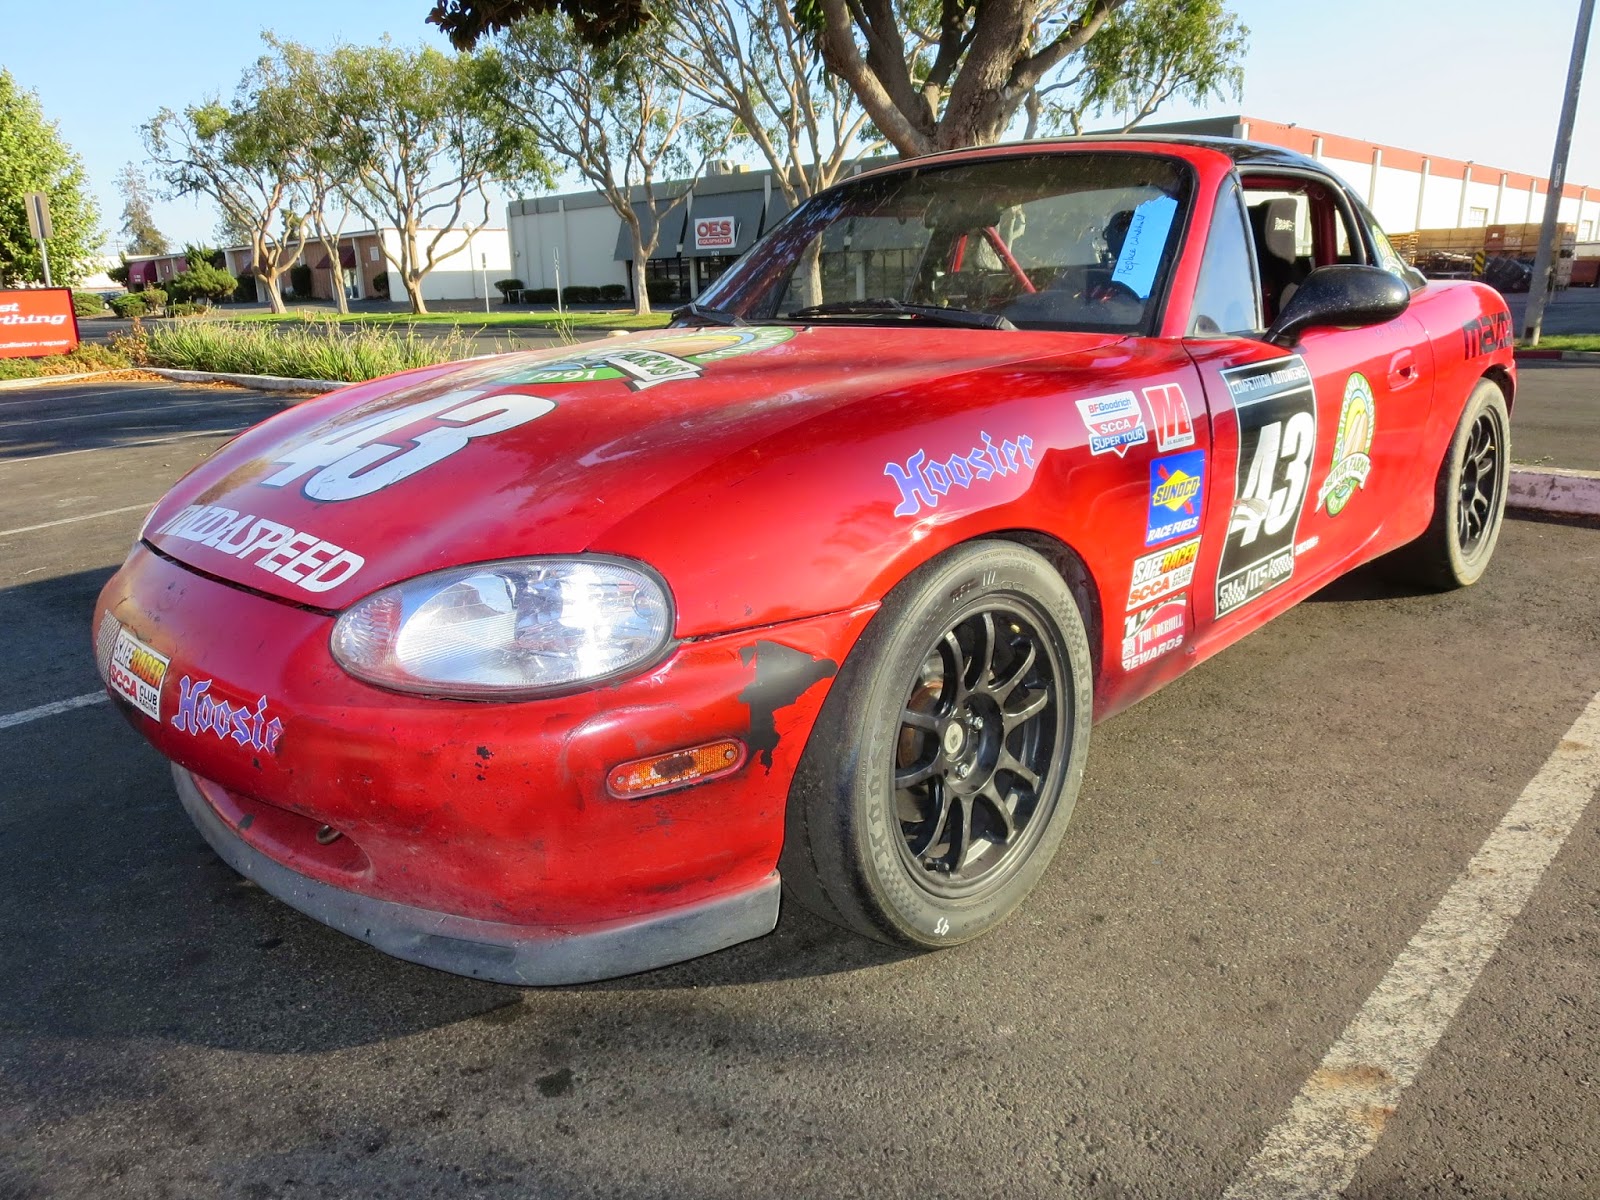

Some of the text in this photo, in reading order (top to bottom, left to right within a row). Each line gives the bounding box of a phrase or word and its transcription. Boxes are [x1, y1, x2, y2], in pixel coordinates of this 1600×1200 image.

[697, 220, 731, 237] OES
[698, 237, 731, 245] EQUIPMENT
[0, 314, 67, 325] thing
[39, 339, 70, 347] repair
[611, 350, 690, 376] ARMS
[526, 369, 597, 381] 1991
[1230, 373, 1272, 394] COMPETITION
[1088, 398, 1131, 414] BFGoodrich
[1100, 419, 1131, 434] SCCA
[260, 390, 557, 501] 43
[1093, 428, 1144, 451] SUPER TOUR
[883, 430, 1035, 518] Hoosier
[1229, 411, 1314, 548] 43
[1154, 478, 1198, 504] SUNOCO
[1146, 516, 1199, 542] RACE FUELS
[154, 504, 366, 592] MAZDASPEED
[1128, 576, 1170, 605] SCCA
[1121, 634, 1184, 671] REWARDS
[110, 664, 158, 706] SCCA CLUB
[139, 697, 158, 715] RACING
[933, 916, 950, 936] 43
